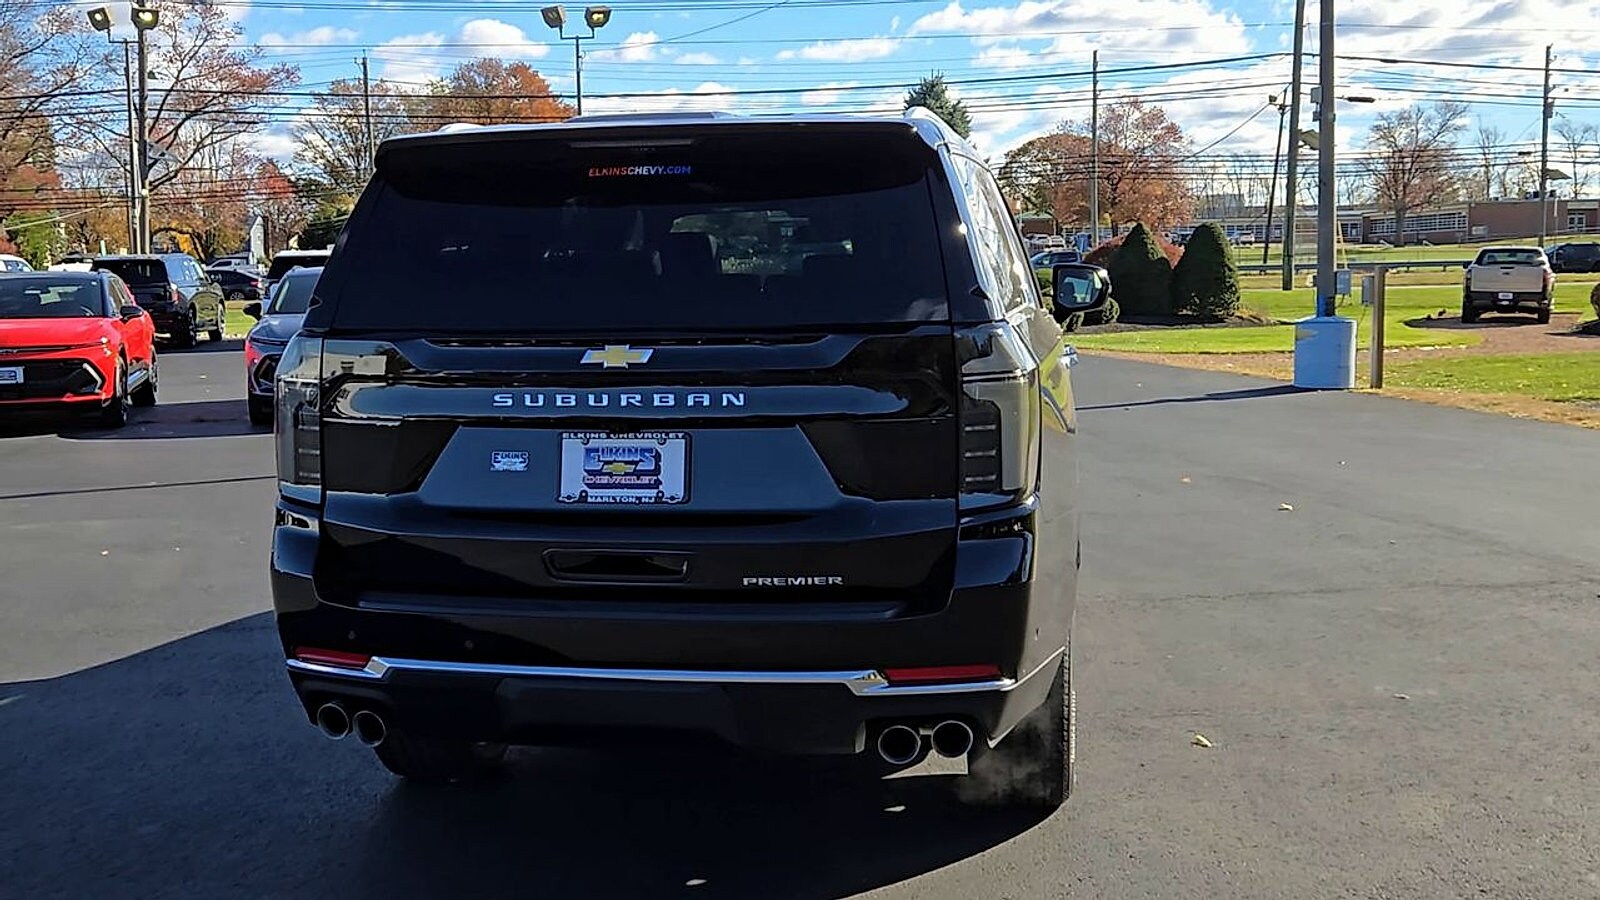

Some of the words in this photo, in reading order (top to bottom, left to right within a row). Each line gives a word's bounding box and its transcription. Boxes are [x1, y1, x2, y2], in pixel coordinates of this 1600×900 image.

[588, 166, 691, 177] ELKINSCHEVY.COM
[493, 393, 744, 406] SUBURBAN
[584, 447, 657, 470] ELKINS
[587, 495, 640, 504] MARLTON,
[642, 495, 656, 503] NJ
[742, 576, 844, 586] PREMIER
